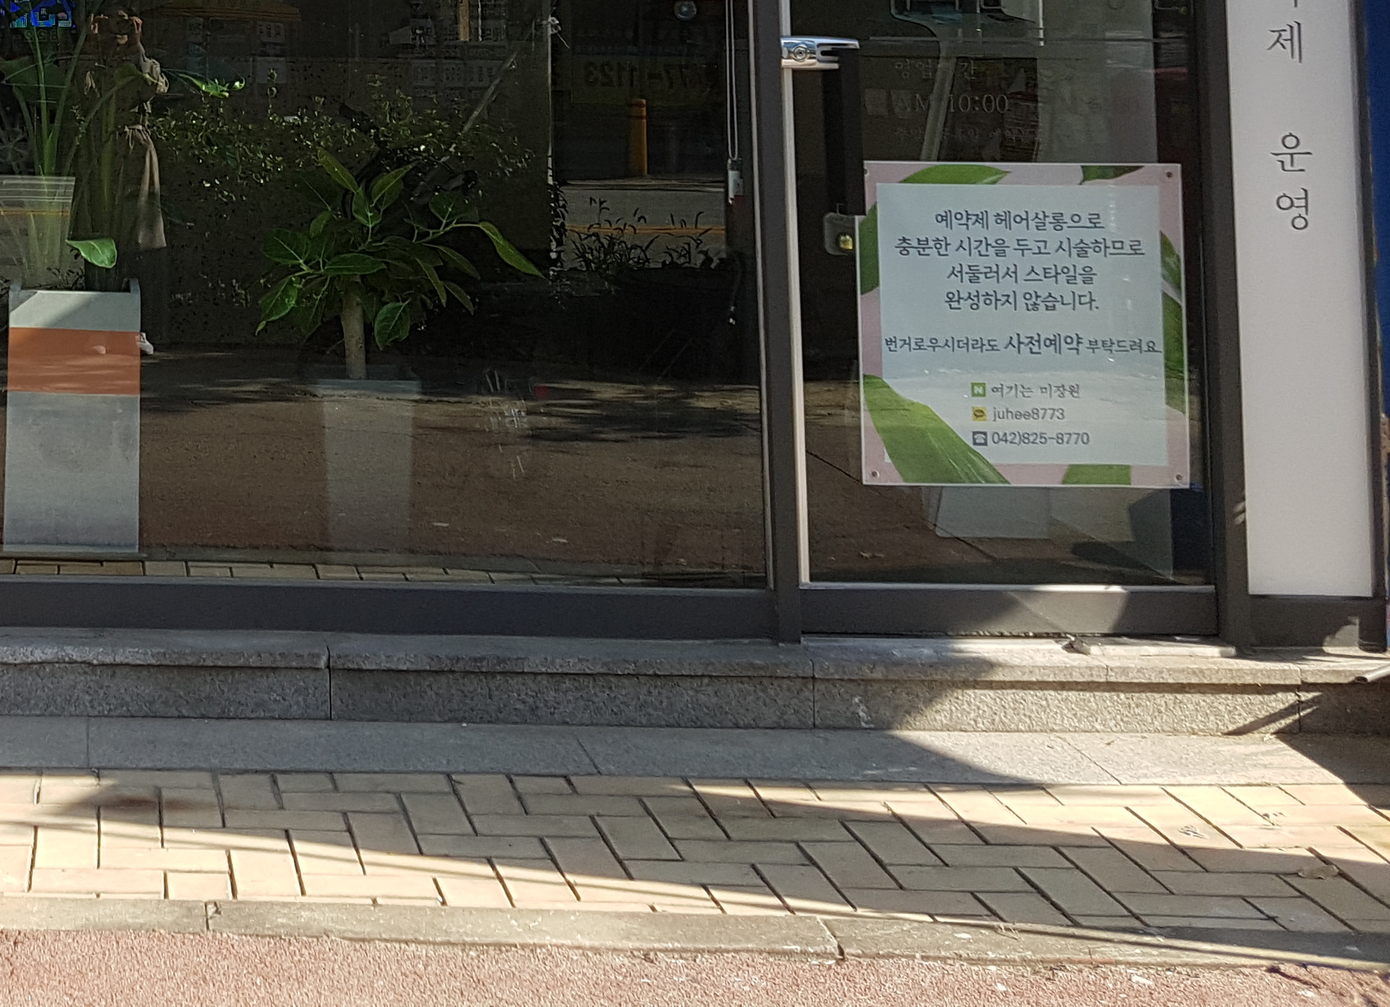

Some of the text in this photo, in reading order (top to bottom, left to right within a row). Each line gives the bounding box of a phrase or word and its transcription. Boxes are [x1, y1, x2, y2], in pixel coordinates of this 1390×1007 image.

[1270, 132, 1313, 231] 운영
[935, 210, 1106, 232] 예약제 헤어살롱으로
[894, 236, 1146, 259] 충분한 시간을 두고 시술하므로
[946, 263, 1098, 285] 서둘러서 스타일을
[945, 289, 1099, 312] 완성하지 않습니다.
[884, 335, 1001, 353] 번거로우시더라도
[1004, 332, 1083, 355] 사전예약
[991, 383, 1034, 399] 여기는
[1040, 383, 1081, 399] 미장원
[992, 407, 1066, 422] juhee8773
[991, 430, 1090, 446] 042)825-8770
